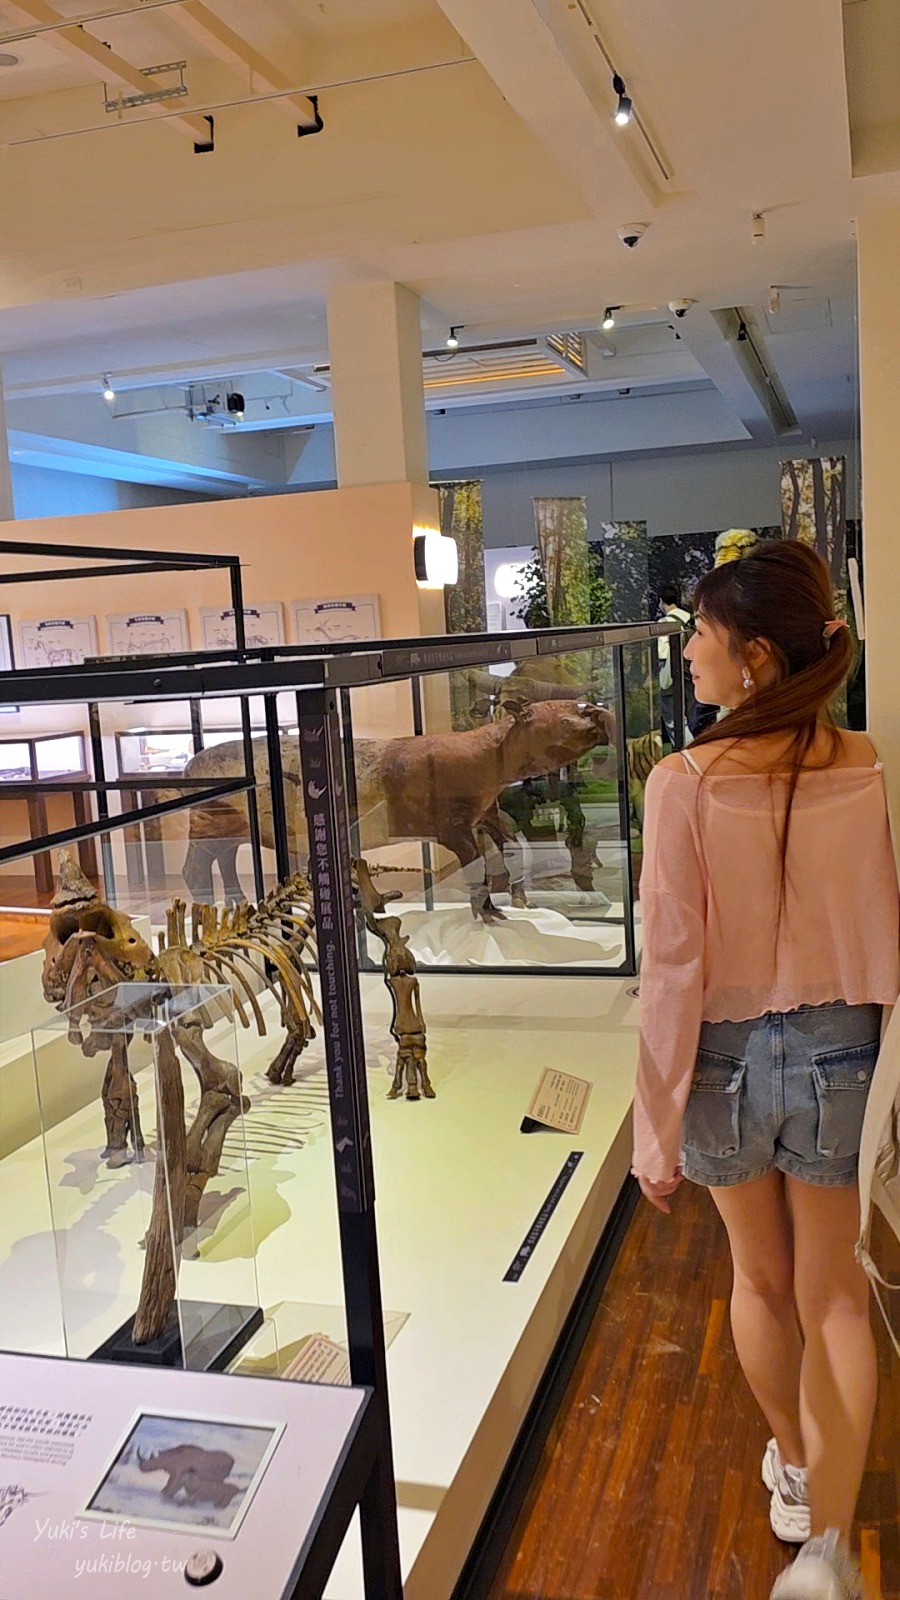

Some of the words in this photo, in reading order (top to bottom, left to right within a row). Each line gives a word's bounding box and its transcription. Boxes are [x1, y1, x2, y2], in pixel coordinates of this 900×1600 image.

[313, 813, 334, 930] 感謝您不觸碰展品
[325, 940, 336, 996] touching.
[329, 996, 339, 1018] not
[329, 1021, 340, 1038] for
[333, 1041, 344, 1065] you
[333, 1065, 344, 1099] Thank
